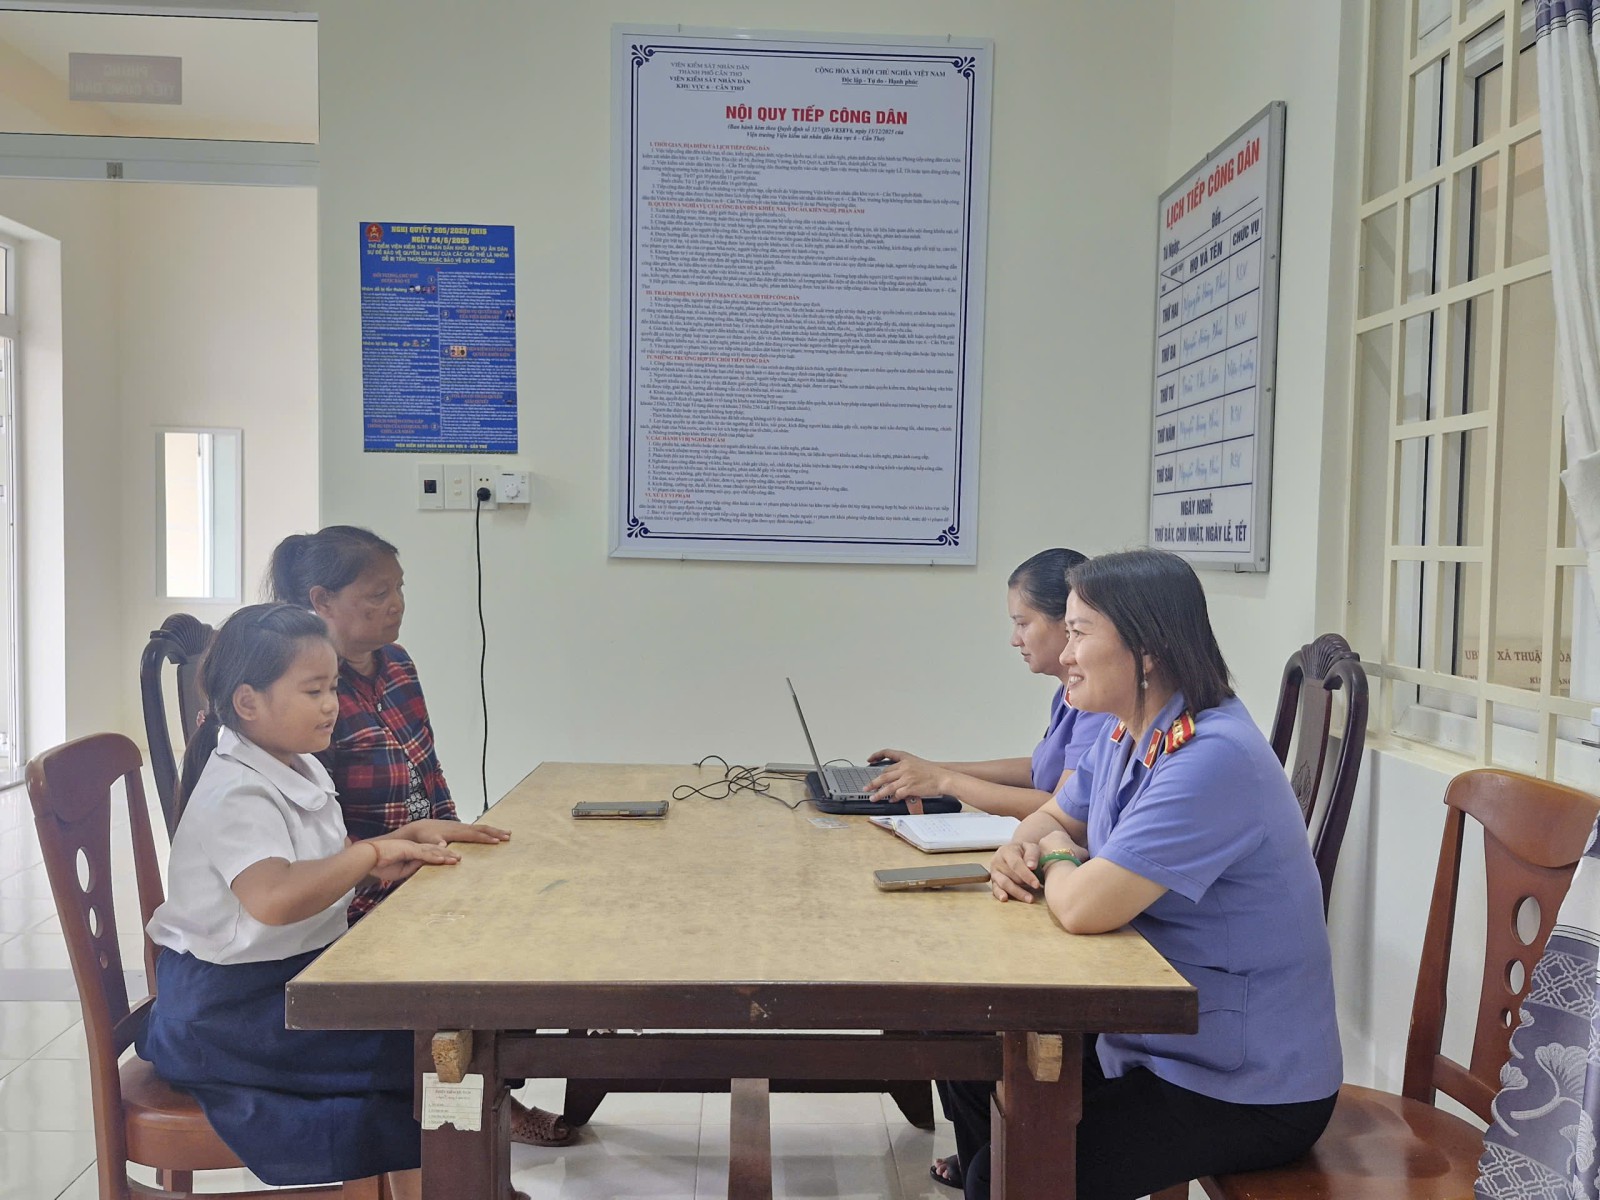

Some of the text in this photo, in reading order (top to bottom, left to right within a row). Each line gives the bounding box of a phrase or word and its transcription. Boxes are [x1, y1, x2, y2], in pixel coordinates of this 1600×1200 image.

[726, 104, 908, 125] NỘI QUY TIẾP CÔNG DÂN
[1166, 137, 1260, 230] LỊCH TIẾP CÔNG DÂN
[409, 225, 432, 234] QUYẾT
[412, 235, 430, 243] NGÀY
[1190, 256, 1198, 273] HỌ
[1200, 248, 1208, 266] VÀ
[1210, 240, 1223, 260] TÊN
[1232, 225, 1249, 246] CHỨC
[1250, 219, 1260, 235] VỤ
[1181, 497, 1196, 516] NGÀY
[1155, 526, 1164, 542] THỨ
[1176, 522, 1187, 542] CHỦ
[1206, 522, 1222, 542] NGÀY
[1235, 520, 1247, 542] TẾT
[1465, 650, 1479, 660] UB
[1497, 649, 1511, 660] XÃ
[1514, 650, 1542, 663] THUẬ
